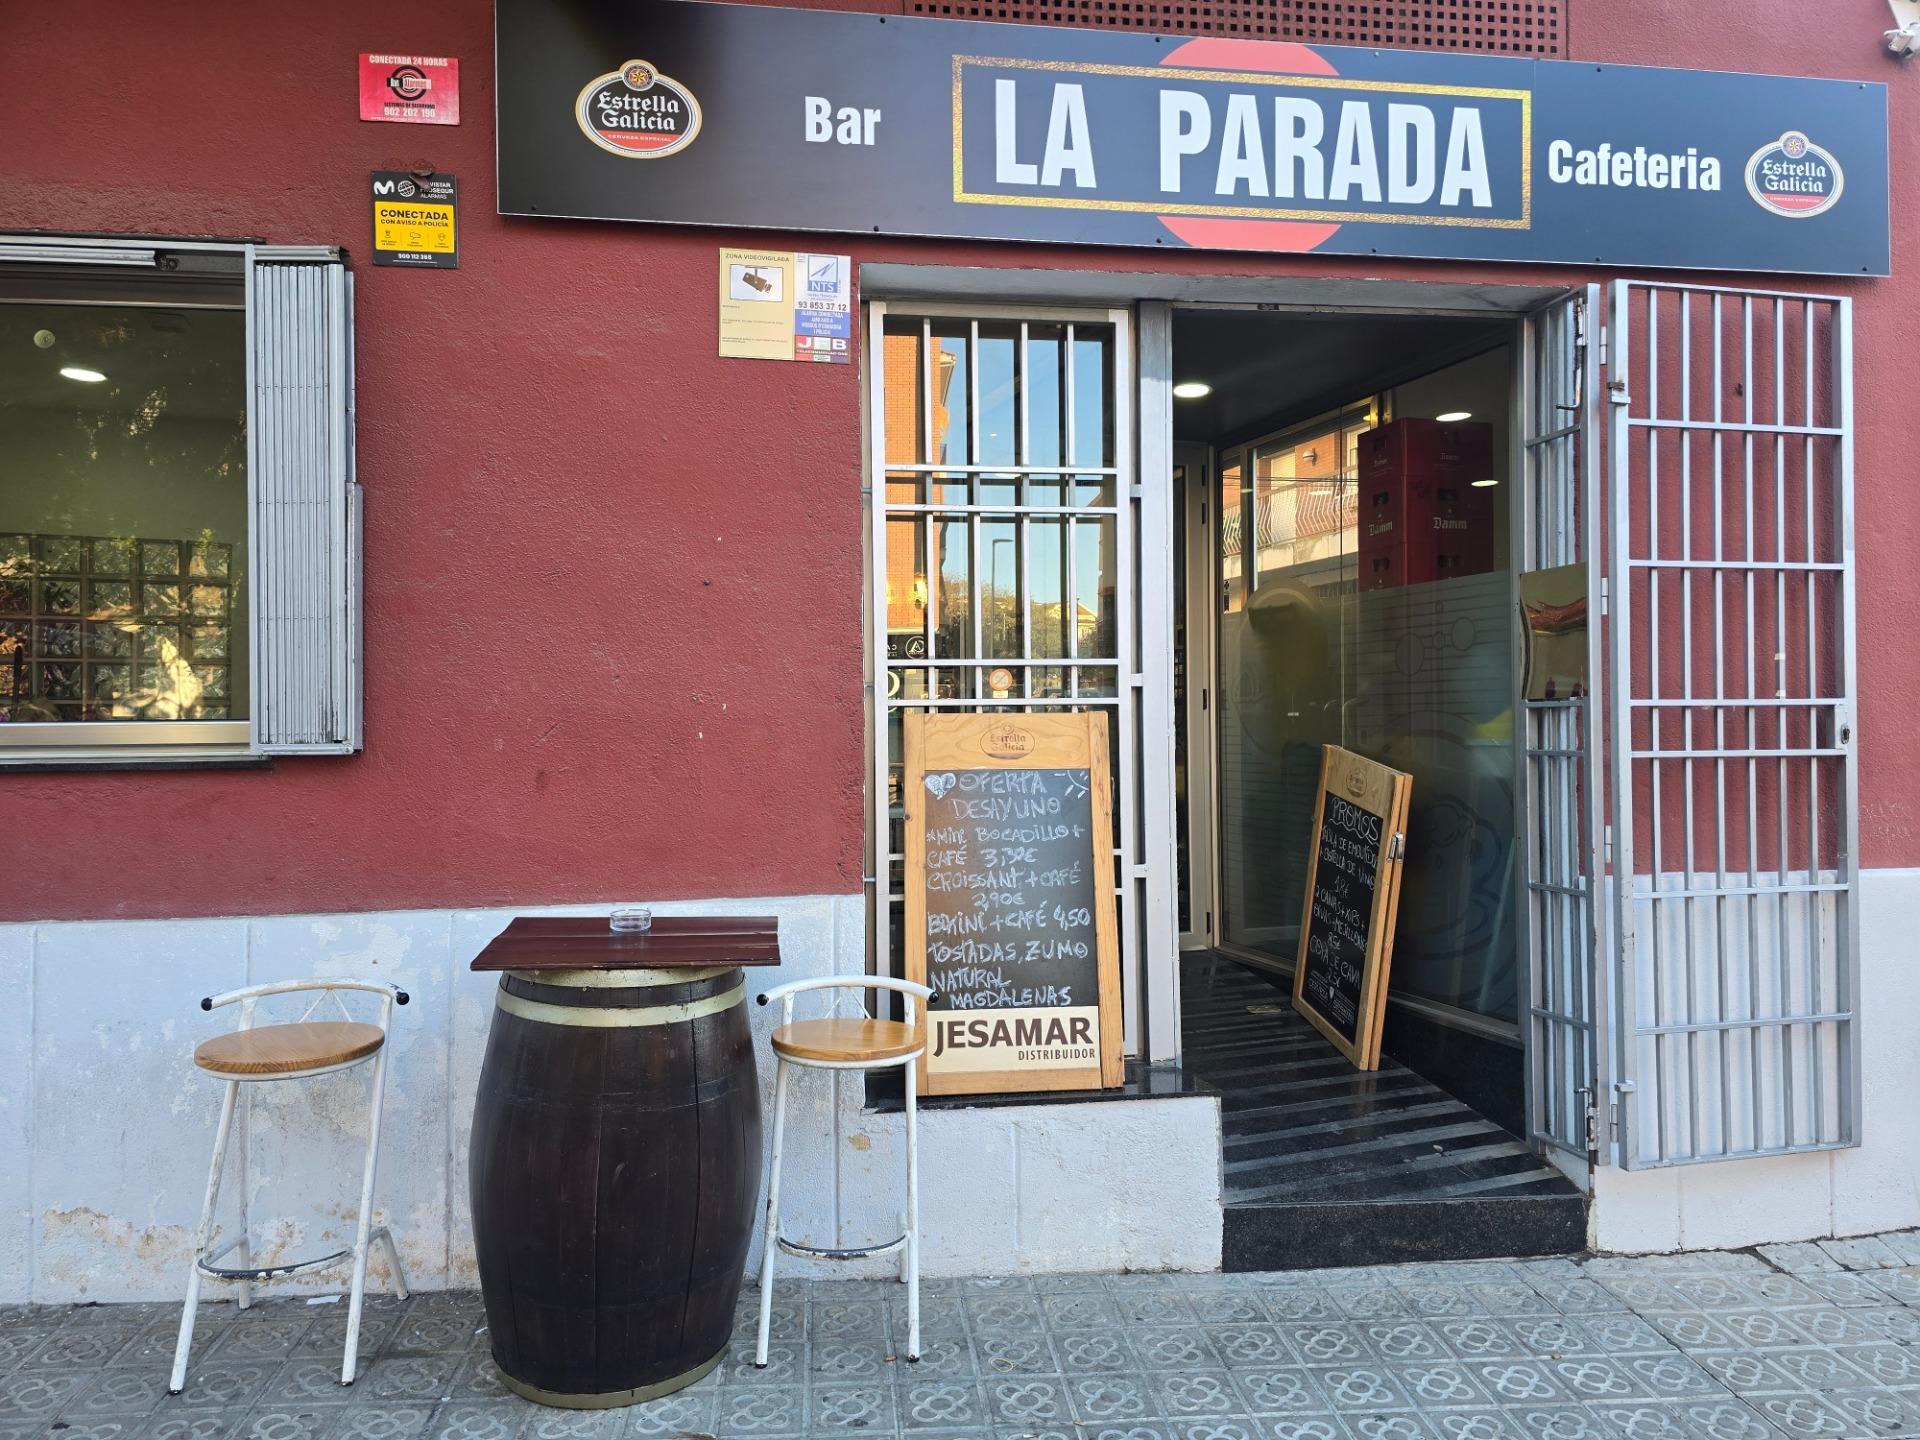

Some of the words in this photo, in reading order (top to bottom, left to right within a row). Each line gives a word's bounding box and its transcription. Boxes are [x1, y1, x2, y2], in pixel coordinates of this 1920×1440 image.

[369, 55, 411, 65] CONECTADA
[413, 57, 421, 65] 24
[423, 57, 448, 66] HORAS
[597, 91, 680, 113] Estrella
[602, 109, 676, 130] Galicia
[805, 96, 881, 145] Bar
[995, 78, 1097, 188] LA
[1160, 89, 1492, 207] PARADA
[1548, 139, 1721, 190] Cafeteria
[1761, 159, 1826, 177] Estrella
[1765, 175, 1823, 192] Galicia
[381, 209, 449, 221] CONECTADA
[744, 254, 790, 262] VIDEOVIGILADA
[811, 282, 834, 292] NTS
[798, 301, 808, 309] 93
[810, 302, 824, 310] 853
[826, 302, 835, 310] 37
[837, 303, 847, 311] 12
[1369, 521, 1393, 536] Damm
[1433, 517, 1467, 529] Damm
[990, 733, 1026, 743] Estrella
[991, 742, 1025, 751] Galicia
[951, 797, 1060, 820] DESAYUNO
[1332, 797, 1379, 841] PROMOS
[975, 825, 1069, 842] BOCADILLO
[927, 845, 967, 868] CAFÉ
[927, 867, 1024, 891] CROISSANT
[929, 967, 1012, 992] NATURAL
[951, 985, 1072, 1010] MAGDALENAS
[933, 1017, 1094, 1057] JESAMAR
[1018, 1048, 1096, 1061] DISTRIBUIDOR
